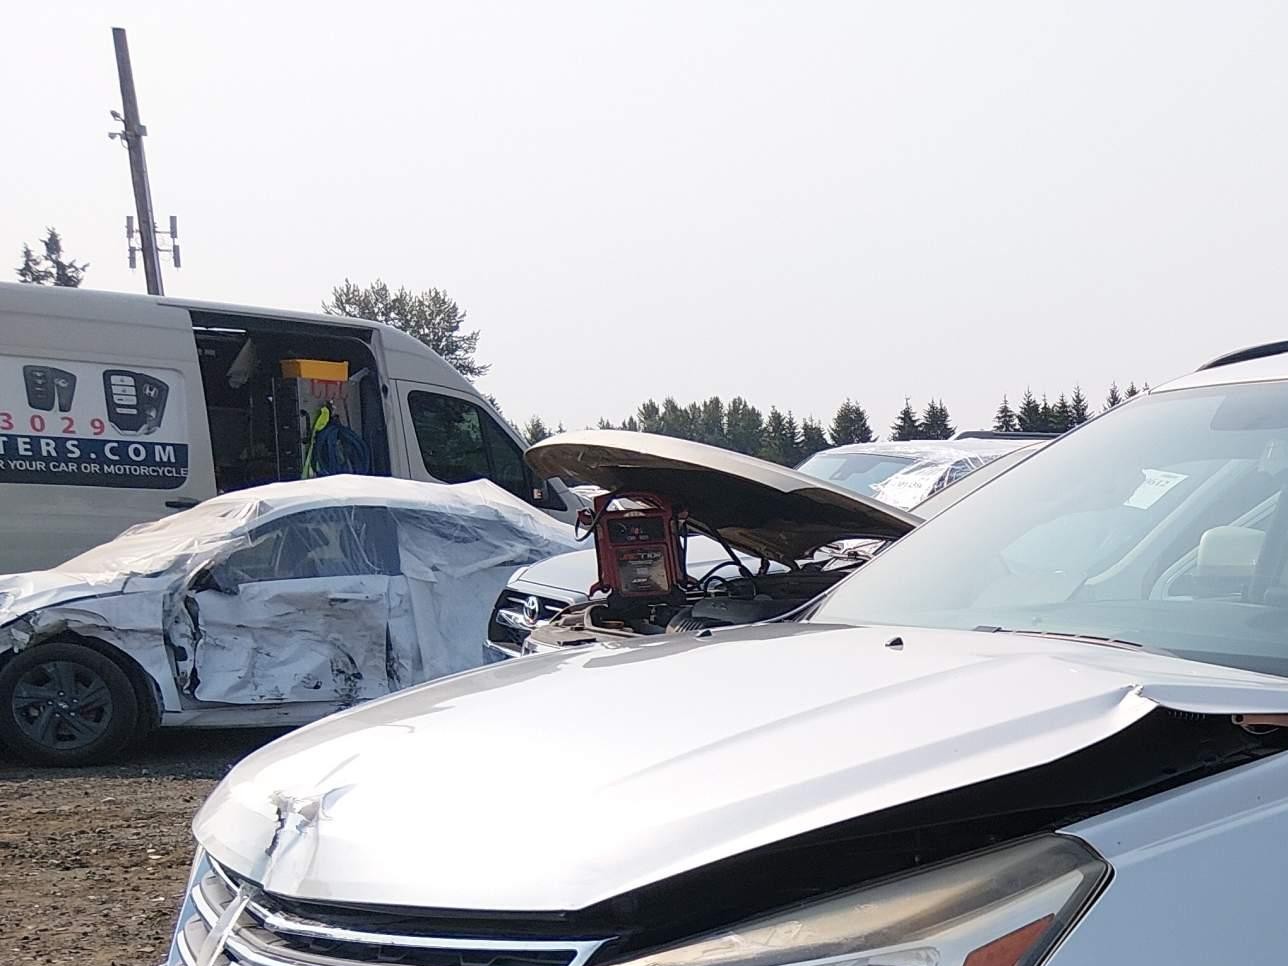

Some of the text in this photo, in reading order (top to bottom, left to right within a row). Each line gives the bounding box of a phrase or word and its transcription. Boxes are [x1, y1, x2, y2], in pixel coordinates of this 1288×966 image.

[8, 460, 46, 472] YOUR
[50, 462, 78, 473] CAR
[81, 463, 100, 474] OR
[104, 464, 188, 478] MOTORCYCLE
